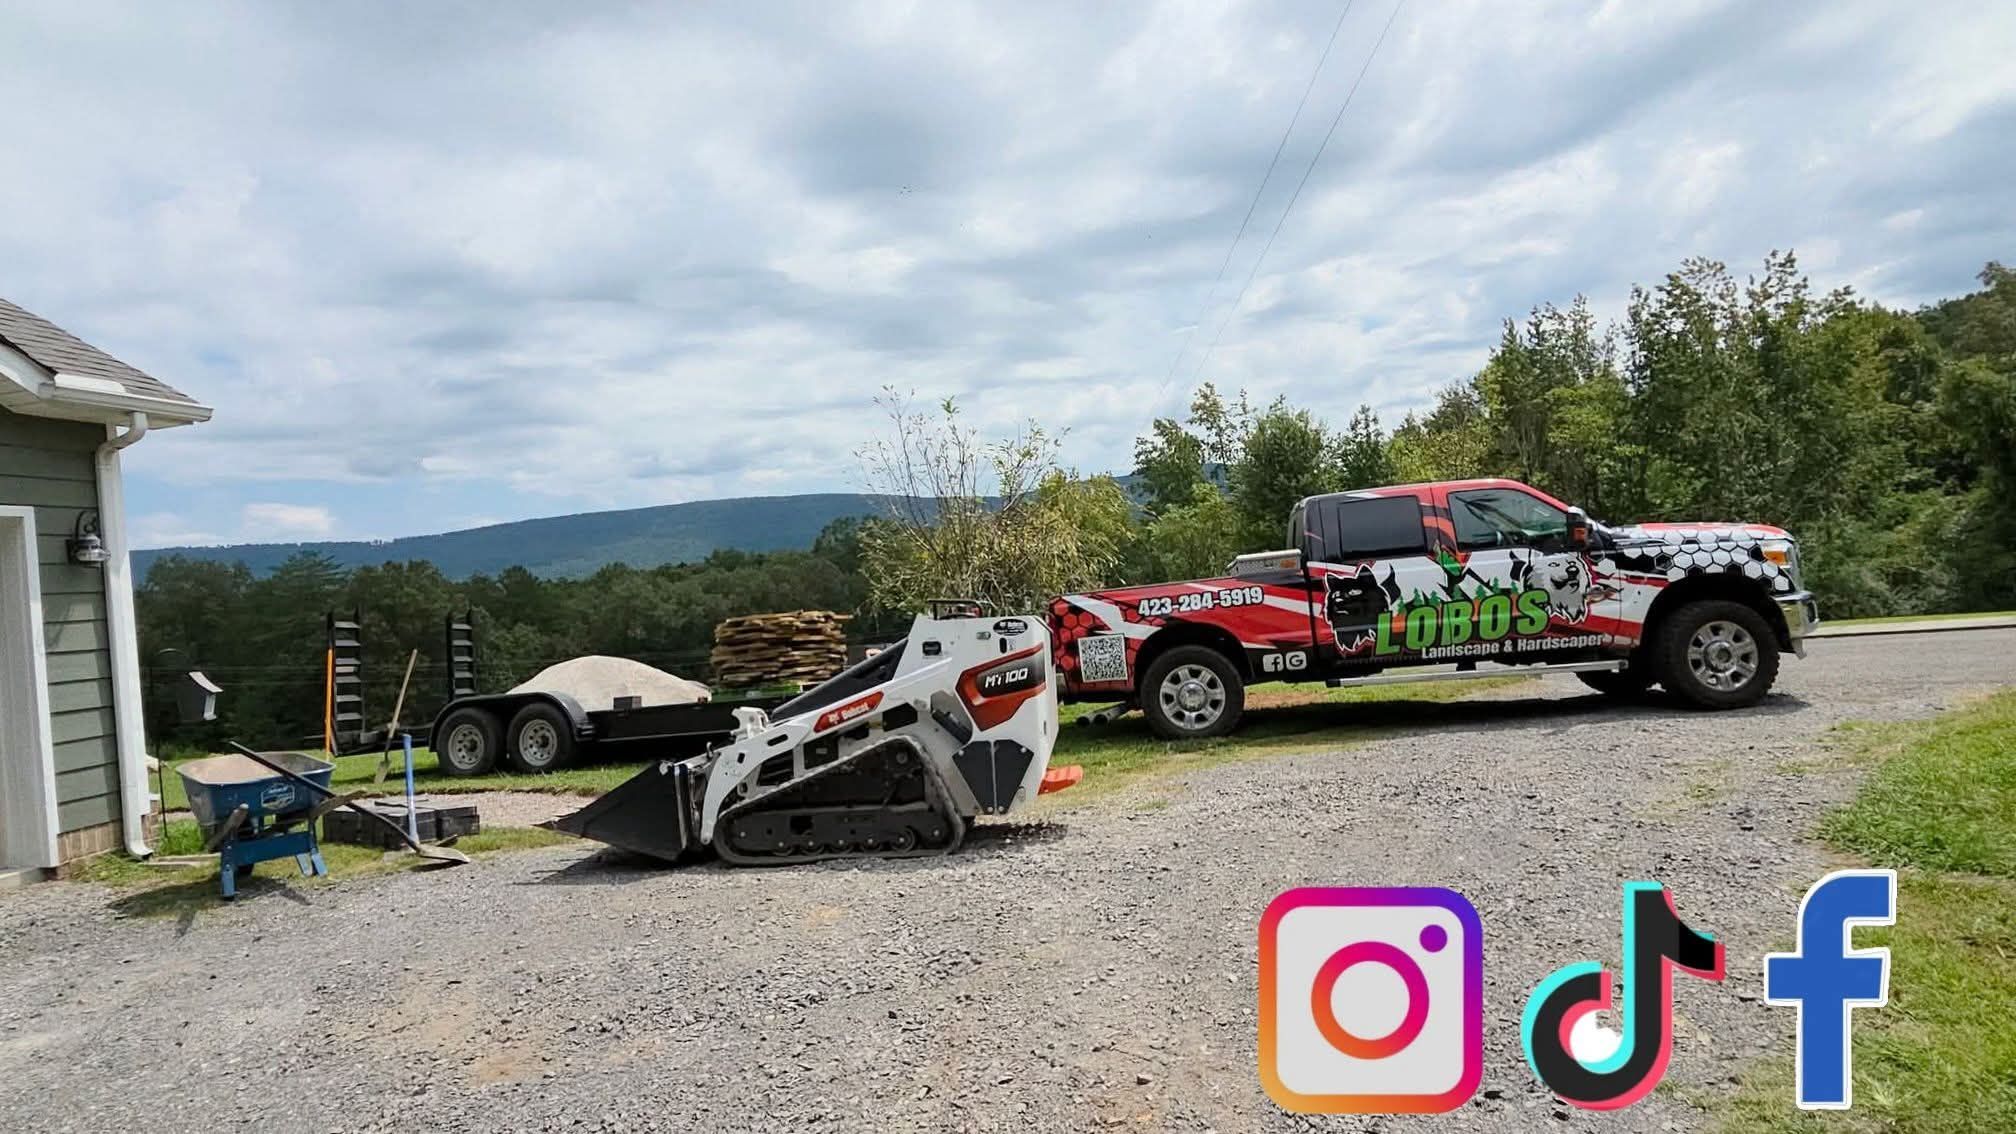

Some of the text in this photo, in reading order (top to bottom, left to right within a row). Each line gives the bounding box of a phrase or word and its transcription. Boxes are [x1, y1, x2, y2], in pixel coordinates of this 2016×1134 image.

[1138, 587, 1263, 616] 423-284-5919
[1376, 589, 1549, 656] LOBOS
[1422, 634, 1603, 659] Landscape & Hardscaper
